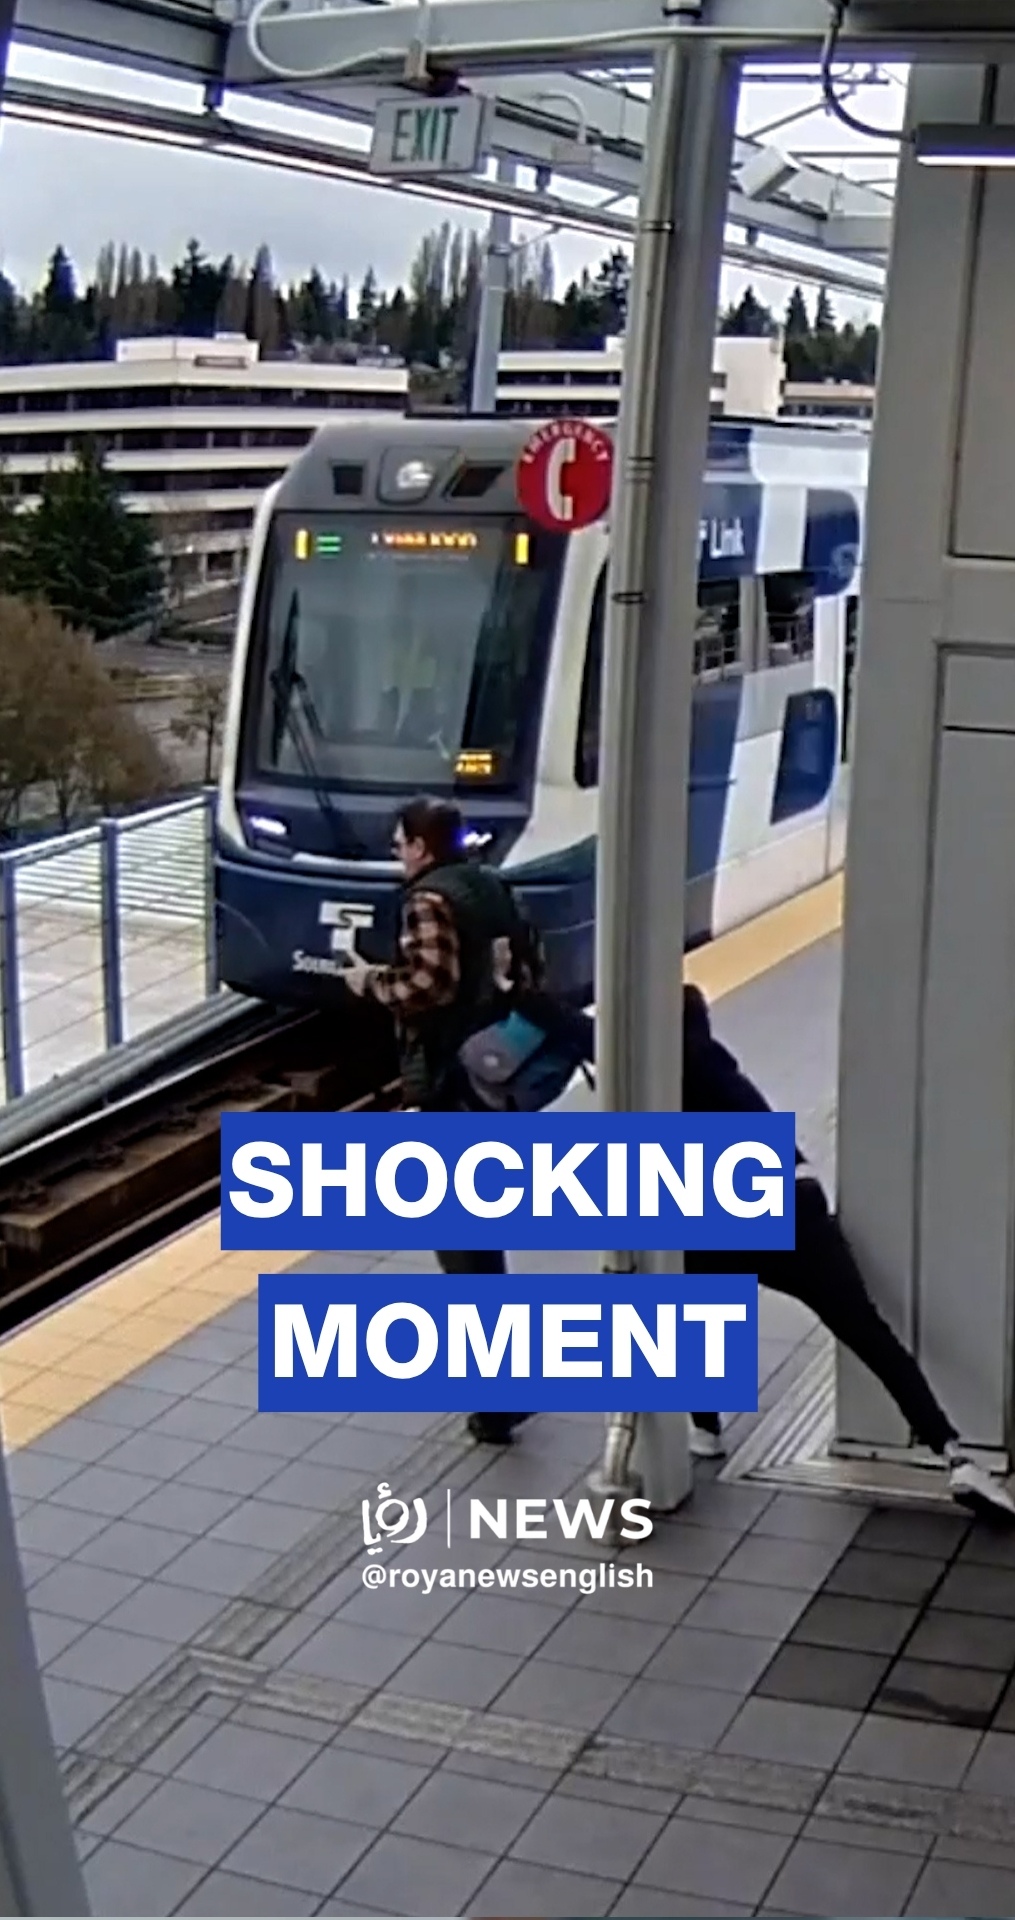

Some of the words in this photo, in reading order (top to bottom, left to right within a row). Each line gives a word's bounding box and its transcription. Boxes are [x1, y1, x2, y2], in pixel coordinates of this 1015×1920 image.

[391, 105, 459, 162] EXIT
[522, 421, 610, 464] EMERGENCY
[710, 517, 745, 558] Link
